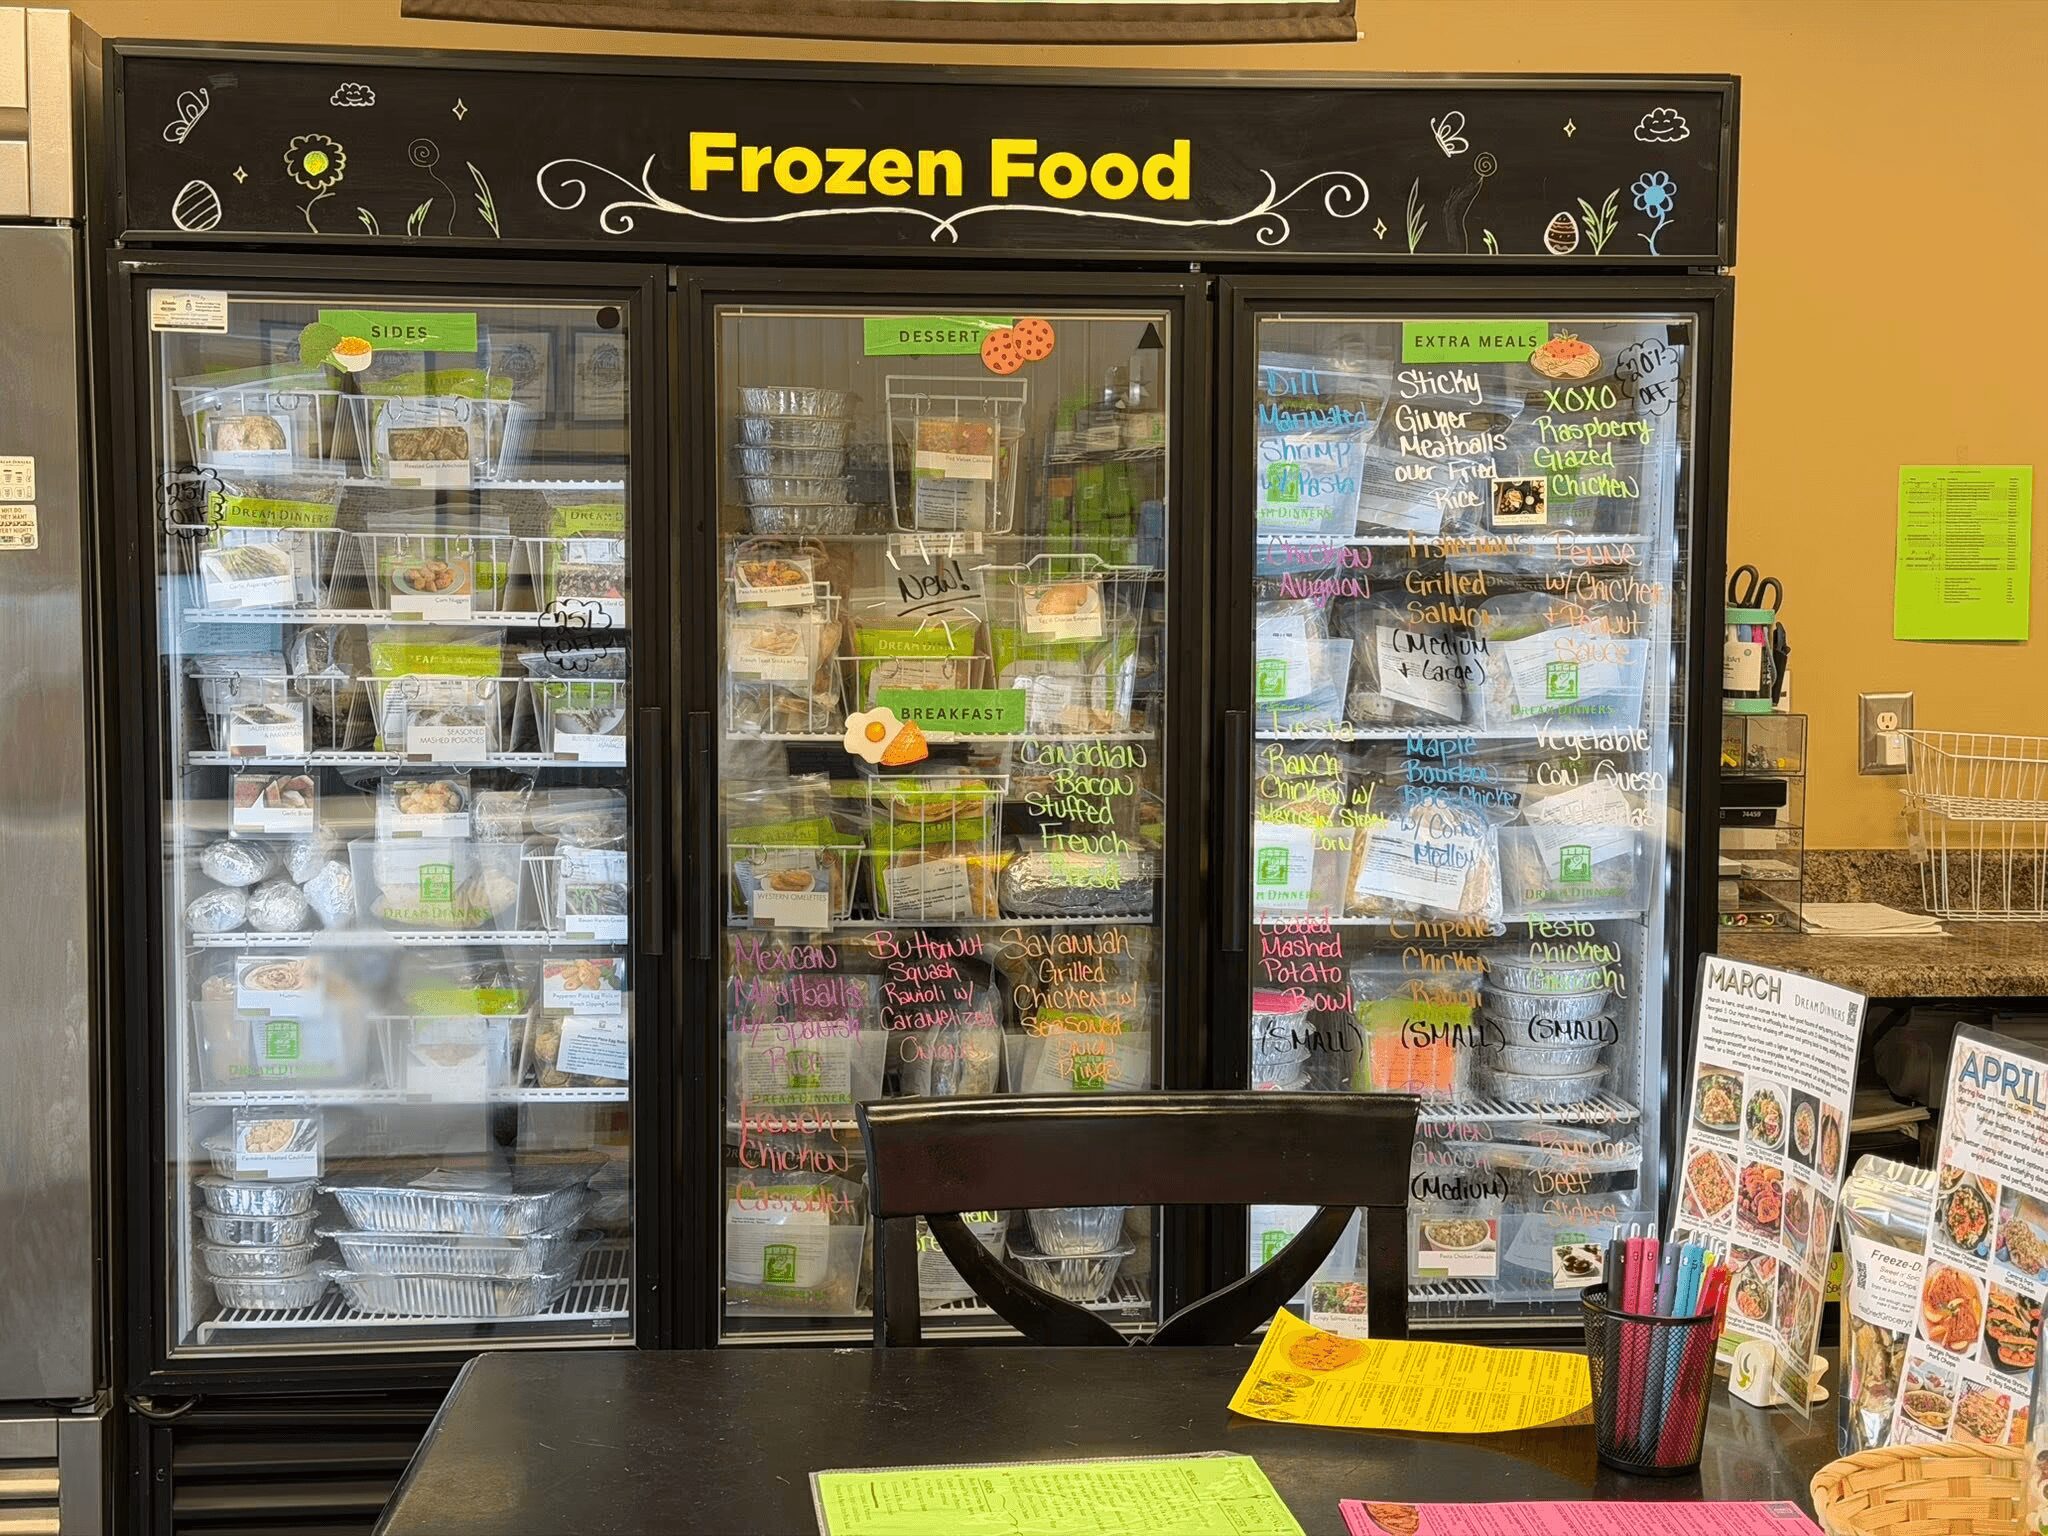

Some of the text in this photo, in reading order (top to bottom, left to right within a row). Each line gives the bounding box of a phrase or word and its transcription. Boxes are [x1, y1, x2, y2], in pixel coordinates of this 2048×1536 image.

[689, 131, 1191, 201] Frozen Food
[371, 325, 428, 339] SIDES
[899, 330, 980, 343] DESSERT
[1414, 336, 1537, 348] EXTRA MEALS
[1626, 348, 1668, 383] 20%
[1266, 365, 1321, 397] Dill
[1398, 368, 1483, 406] Sticky
[1639, 380, 1670, 406] OFF
[1543, 385, 1617, 414] XOXO
[1259, 401, 1369, 433] Marinated
[1395, 404, 1472, 437] Ginger
[1532, 415, 1656, 449] Raspberry
[1259, 437, 1350, 467] Shrimp
[1400, 433, 1508, 460] Meatballs
[1533, 441, 1616, 472] Glazed
[1298, 468, 1356, 498] Pasta
[1395, 457, 1500, 484] over Fried
[1427, 487, 1485, 511] Rice
[1551, 473, 1640, 499] Chicken
[232, 506, 329, 523] DREAM DINNERS
[1267, 537, 1374, 569] Chicken
[1546, 529, 1643, 566] Penne
[897, 560, 970, 603] New!
[1279, 571, 1371, 609] Avignon
[1405, 568, 1488, 596] Grilled
[1545, 569, 1672, 607] w/ Chicken
[1407, 600, 1501, 628] Salmon
[1393, 628, 1491, 657] (Medium
[1423, 658, 1487, 689] Large)
[900, 708, 1004, 720] BREAKFAST
[420, 737, 486, 745] MASHED POTATOES
[446, 728, 486, 736] SEASONED
[1533, 717, 1652, 761] Vegetable
[1021, 738, 1147, 769] Canadian
[1261, 742, 1346, 785] Ranch
[1407, 732, 1479, 767] Maple
[1049, 768, 1134, 796] Bacon
[1400, 758, 1498, 785] Bourbon
[1537, 759, 1665, 792] Con Queso
[1024, 791, 1115, 825] Stuffed
[1261, 773, 1375, 814] Chicken w/
[1039, 822, 1131, 859] French
[1400, 811, 1424, 840] w/
[1413, 840, 1477, 870] Medley
[757, 893, 789, 901] WESTERN
[1258, 908, 1332, 936] Loaded
[1528, 911, 1595, 940] Pesto
[735, 934, 837, 973] Mexican
[862, 930, 985, 960] Butternut
[1000, 927, 1135, 960] Savannah
[1261, 932, 1344, 959] Mashed
[1529, 941, 1622, 965] Chicken
[888, 962, 962, 989] Squash
[1039, 957, 1108, 986] Grilled
[1258, 957, 1343, 984] Potato
[1402, 946, 1494, 976] Chicken
[734, 974, 865, 1010] Meatballs
[879, 980, 974, 1007] Ravioli w/
[1013, 981, 1138, 1011] Chicken w/
[1707, 963, 1782, 1005] MARCH
[1280, 985, 1355, 1014] Bowl
[880, 1000, 999, 1032] Caramelized
[1020, 1014, 1123, 1038] Seasoned
[1527, 1014, 1619, 1046] (SMALL)
[1261, 1019, 1364, 1063] (SMALL)
[1401, 1017, 1507, 1055] (SMALL)
[1958, 1050, 2046, 1111] APRIL
[1415, 1120, 1494, 1142] hicken
[738, 1138, 849, 1173] Chicken
[1410, 1171, 1510, 1202] (Medium)
[1528, 1165, 1593, 1196] Beef
